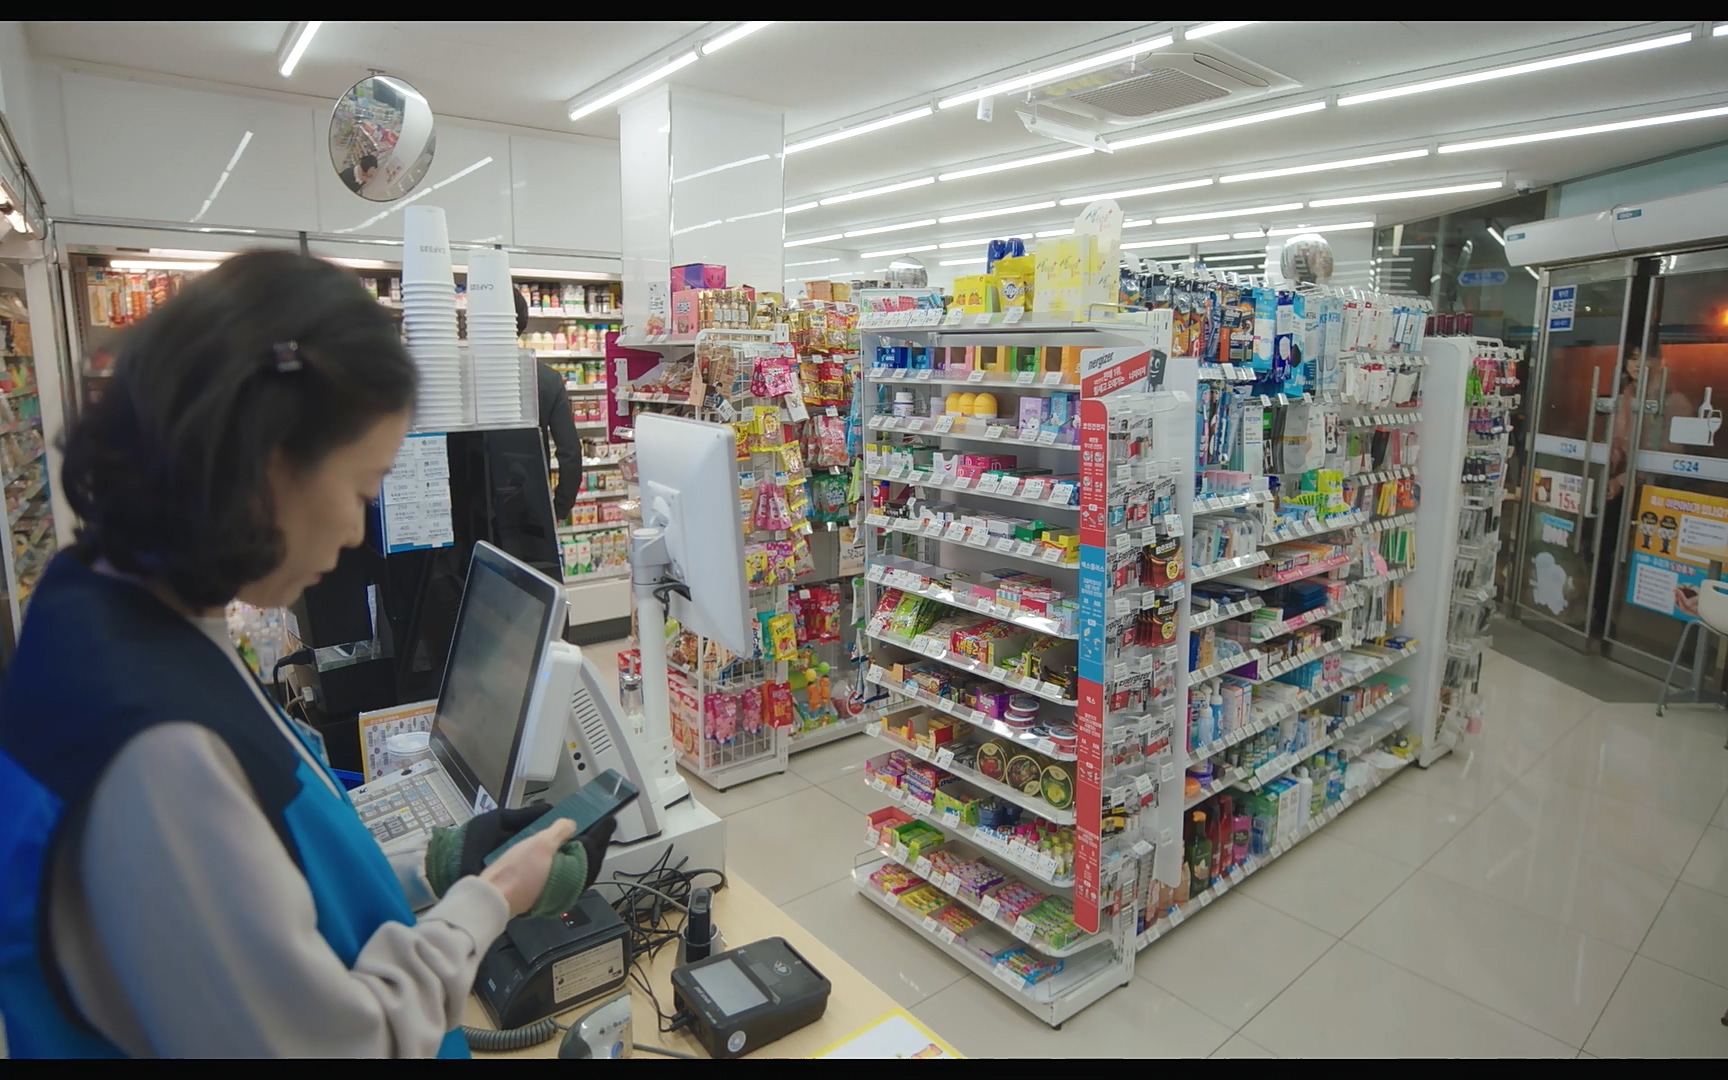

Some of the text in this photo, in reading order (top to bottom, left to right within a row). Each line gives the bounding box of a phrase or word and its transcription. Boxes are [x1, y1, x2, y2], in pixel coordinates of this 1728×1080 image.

[1551, 301, 1573, 313] SAFE
[1672, 459, 1700, 473] CS24
[1155, 539, 1177, 554] Bexel
[1016, 845, 1026, 853] 2+1
[1030, 851, 1040, 859] 2+1
[1047, 860, 1057, 868] 2+1
